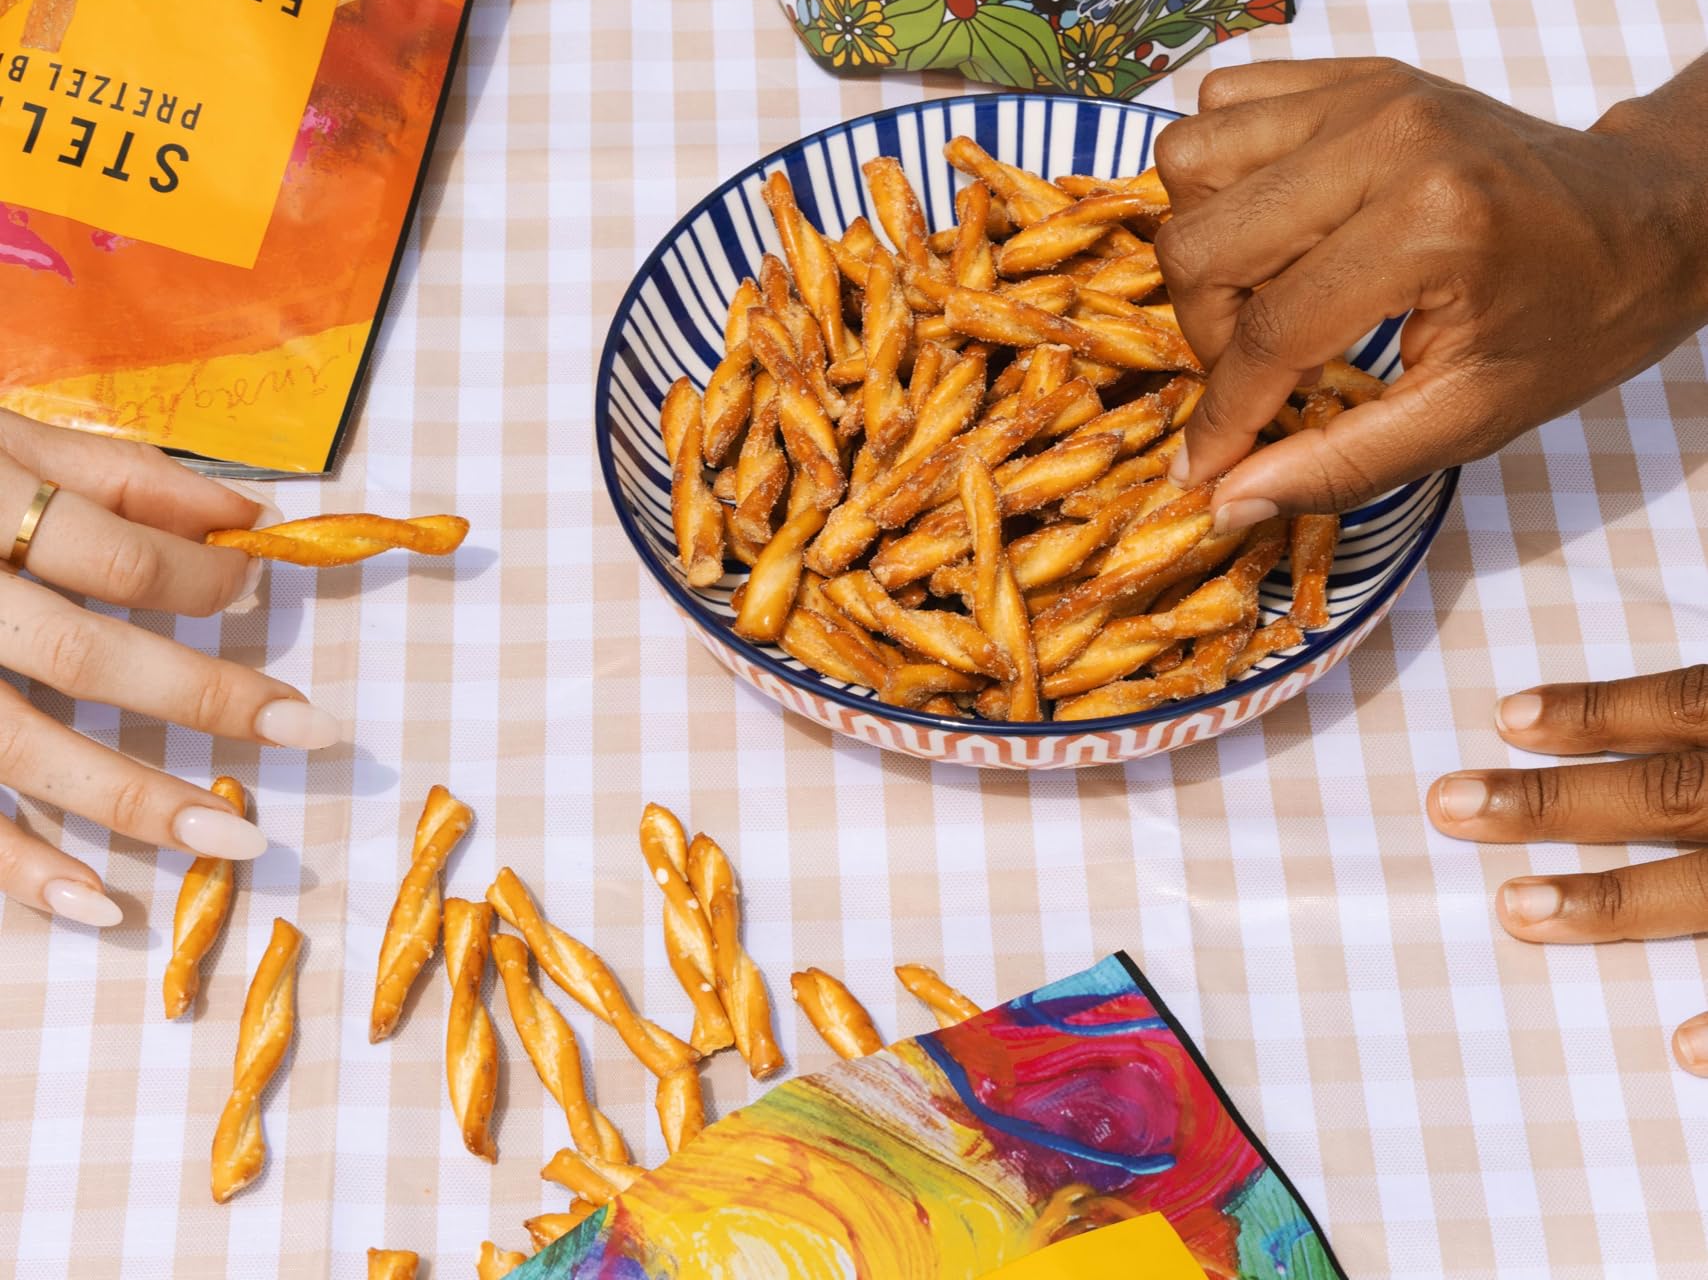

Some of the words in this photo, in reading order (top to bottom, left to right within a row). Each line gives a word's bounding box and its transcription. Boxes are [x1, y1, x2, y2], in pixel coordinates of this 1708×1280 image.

[0, 53, 30, 83] B
[49, 62, 203, 130] PRETZEL
[0, 96, 189, 193] STEL
